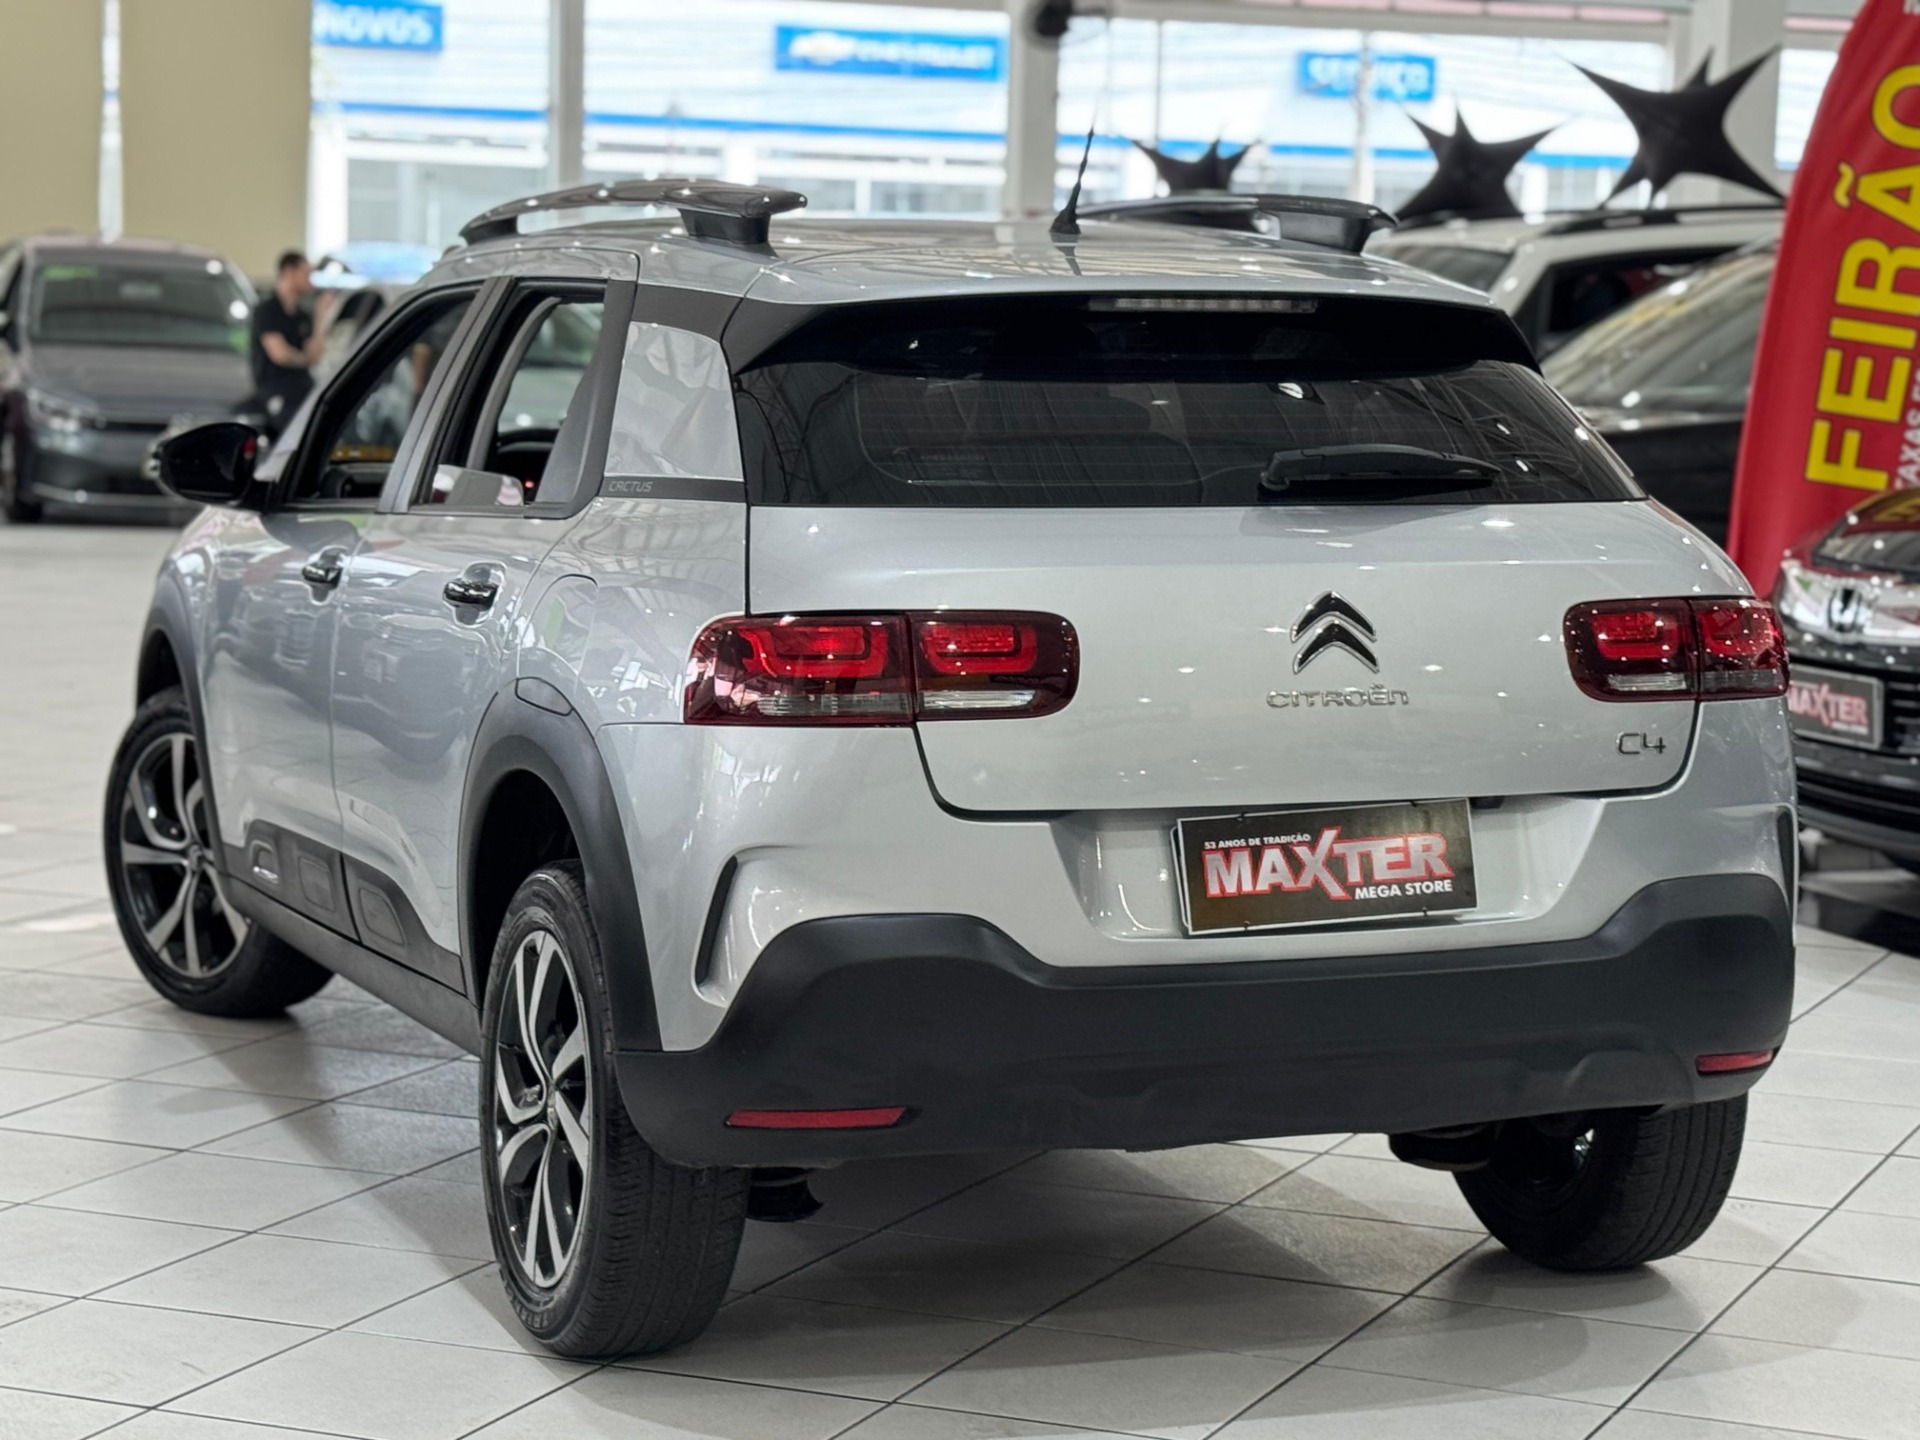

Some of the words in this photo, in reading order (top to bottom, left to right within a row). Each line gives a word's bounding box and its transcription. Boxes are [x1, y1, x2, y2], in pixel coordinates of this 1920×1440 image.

[608, 480, 654, 493] CACTUS
[1616, 731, 1667, 756] C4
[1204, 840, 1219, 851] 53
[1218, 837, 1247, 850] ANOS
[1248, 836, 1261, 847] DE
[1262, 831, 1312, 846] TRADIÇÃO
[1202, 826, 1454, 900] MAXTER
[1354, 884, 1403, 901] MEGA
[1404, 879, 1454, 897] STORE
